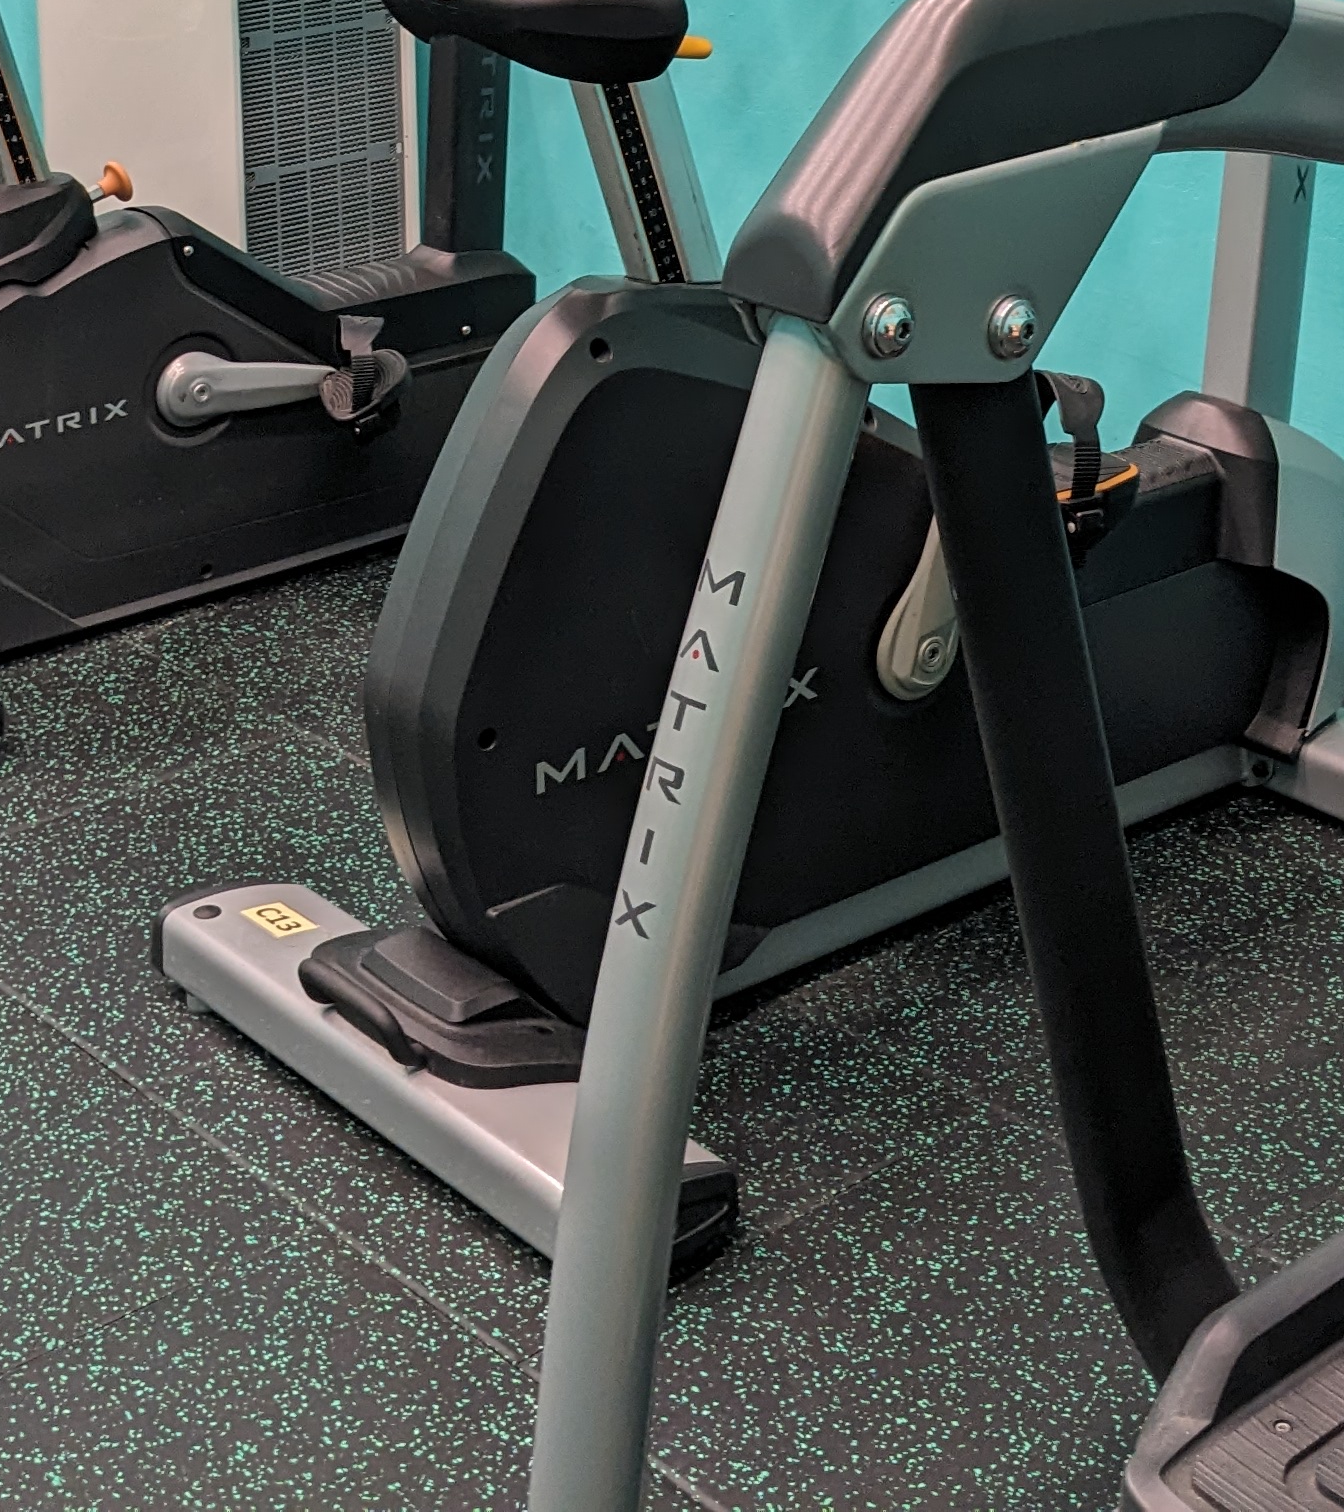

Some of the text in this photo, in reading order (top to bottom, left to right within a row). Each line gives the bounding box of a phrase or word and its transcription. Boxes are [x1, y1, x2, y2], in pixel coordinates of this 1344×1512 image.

[535, 666, 818, 795] MAX
[614, 558, 747, 940] MATRIX
[256, 907, 302, 931] C13
